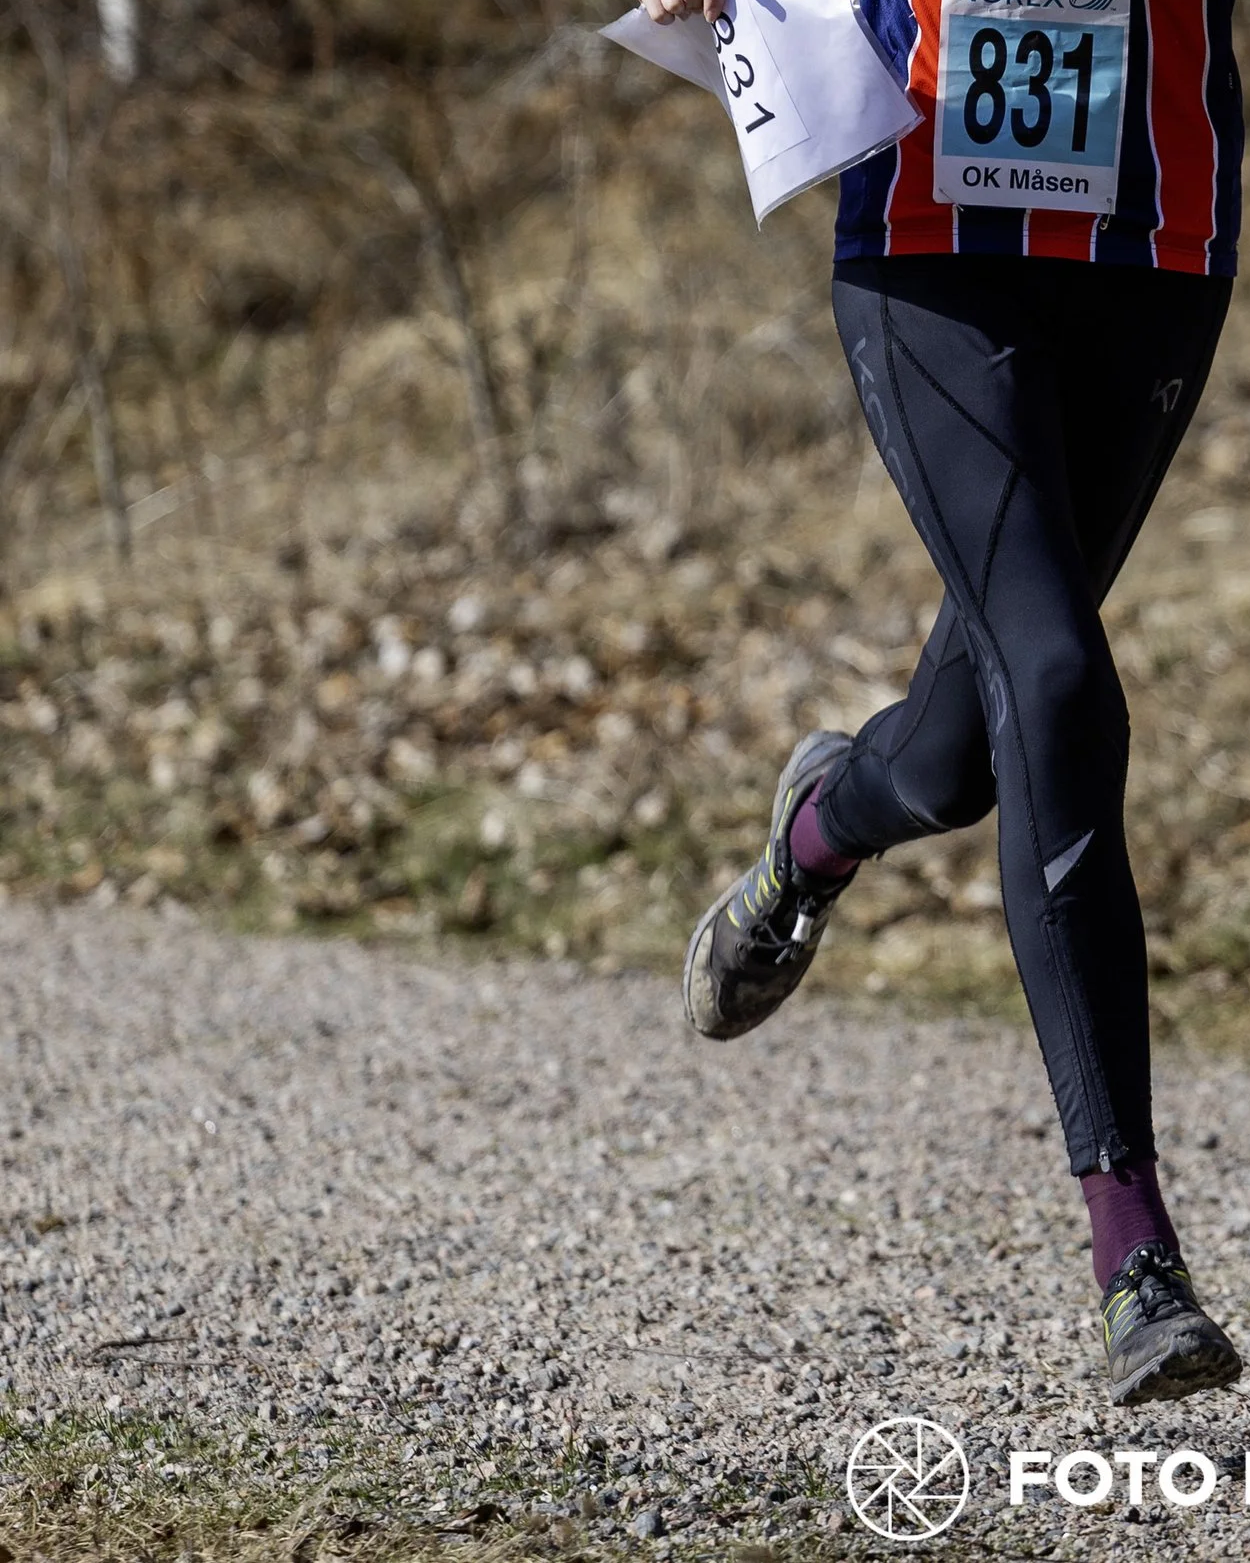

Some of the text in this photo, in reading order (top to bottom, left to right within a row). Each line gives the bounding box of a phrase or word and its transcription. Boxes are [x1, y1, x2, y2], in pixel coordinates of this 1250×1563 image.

[962, 27, 1096, 153] 831
[962, 165, 1090, 195] OK Måsen
